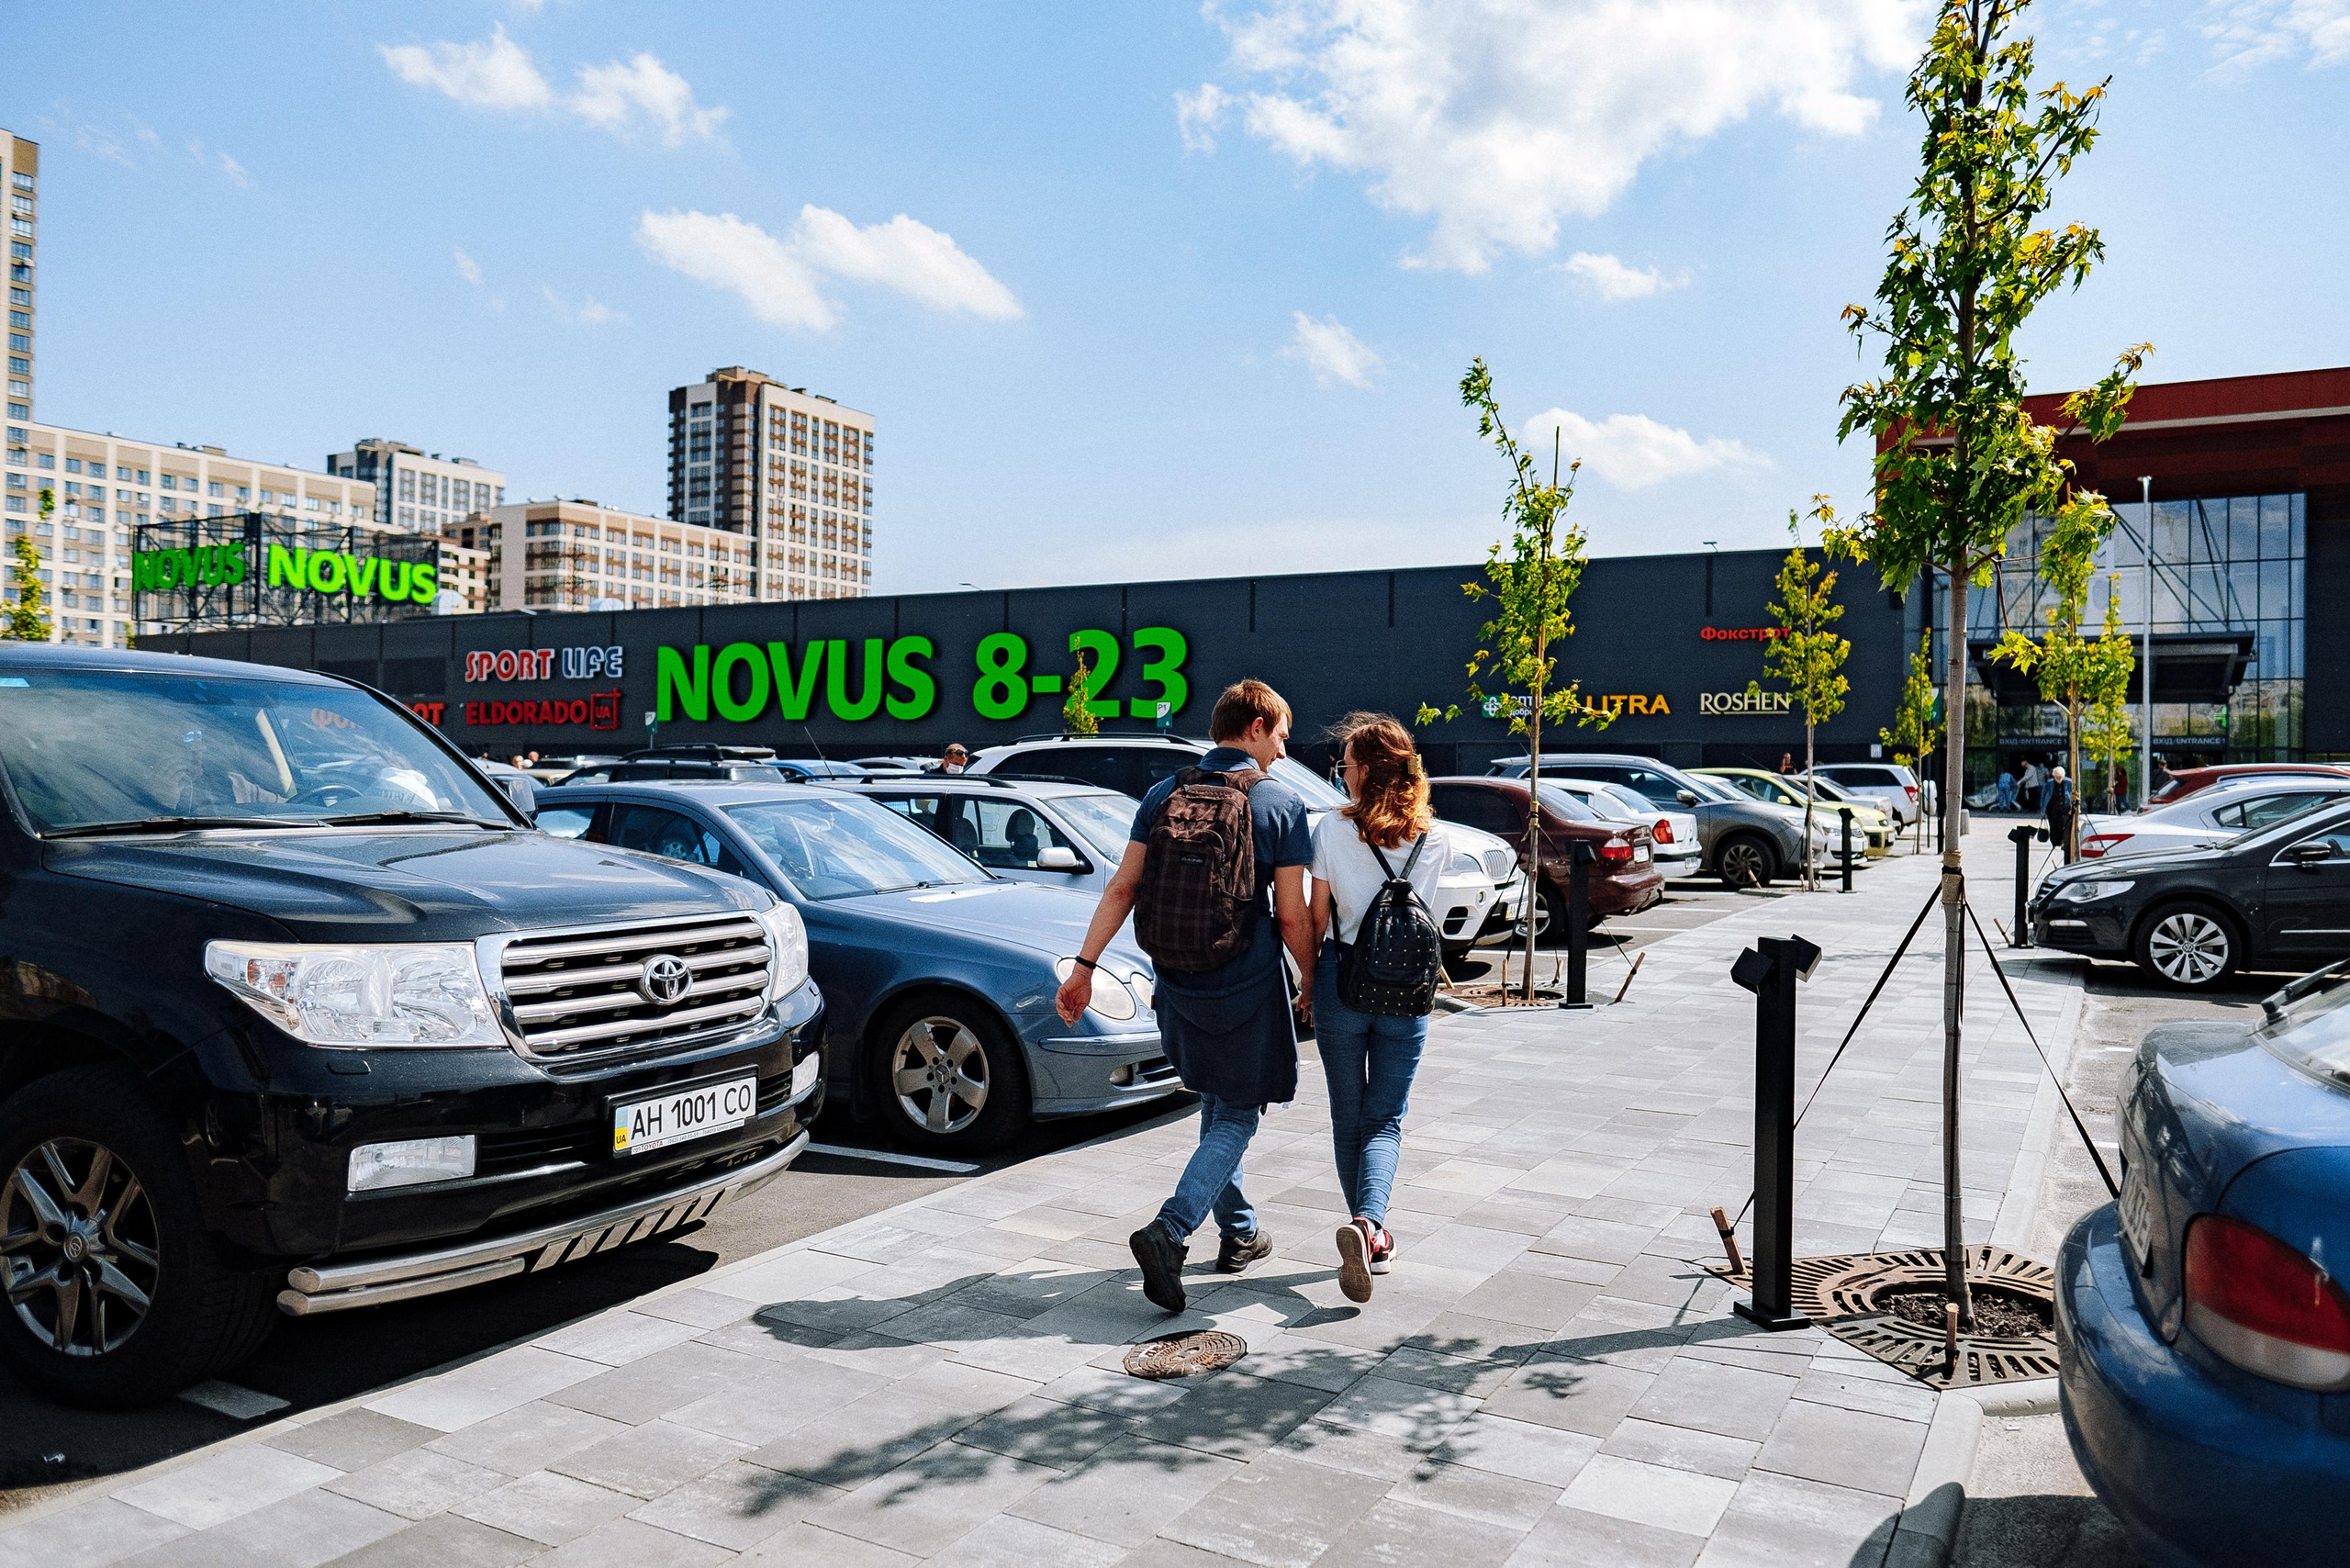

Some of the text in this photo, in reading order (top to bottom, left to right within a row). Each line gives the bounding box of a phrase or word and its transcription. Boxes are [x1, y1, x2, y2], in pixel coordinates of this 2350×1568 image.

[133, 543, 246, 591] NOVUS
[269, 543, 438, 604] NOVUS
[465, 646, 622, 682] SPORT LIFE
[657, 627, 1187, 722] NOVUS 8-23
[465, 700, 611, 724] ELDORADO UA
[1700, 692, 1790, 714] ROSHEN
[631, 1084, 751, 1140] AH 1001 CO
[616, 1134, 627, 1145] UA
[641, 1140, 664, 1151] TOYOTA
